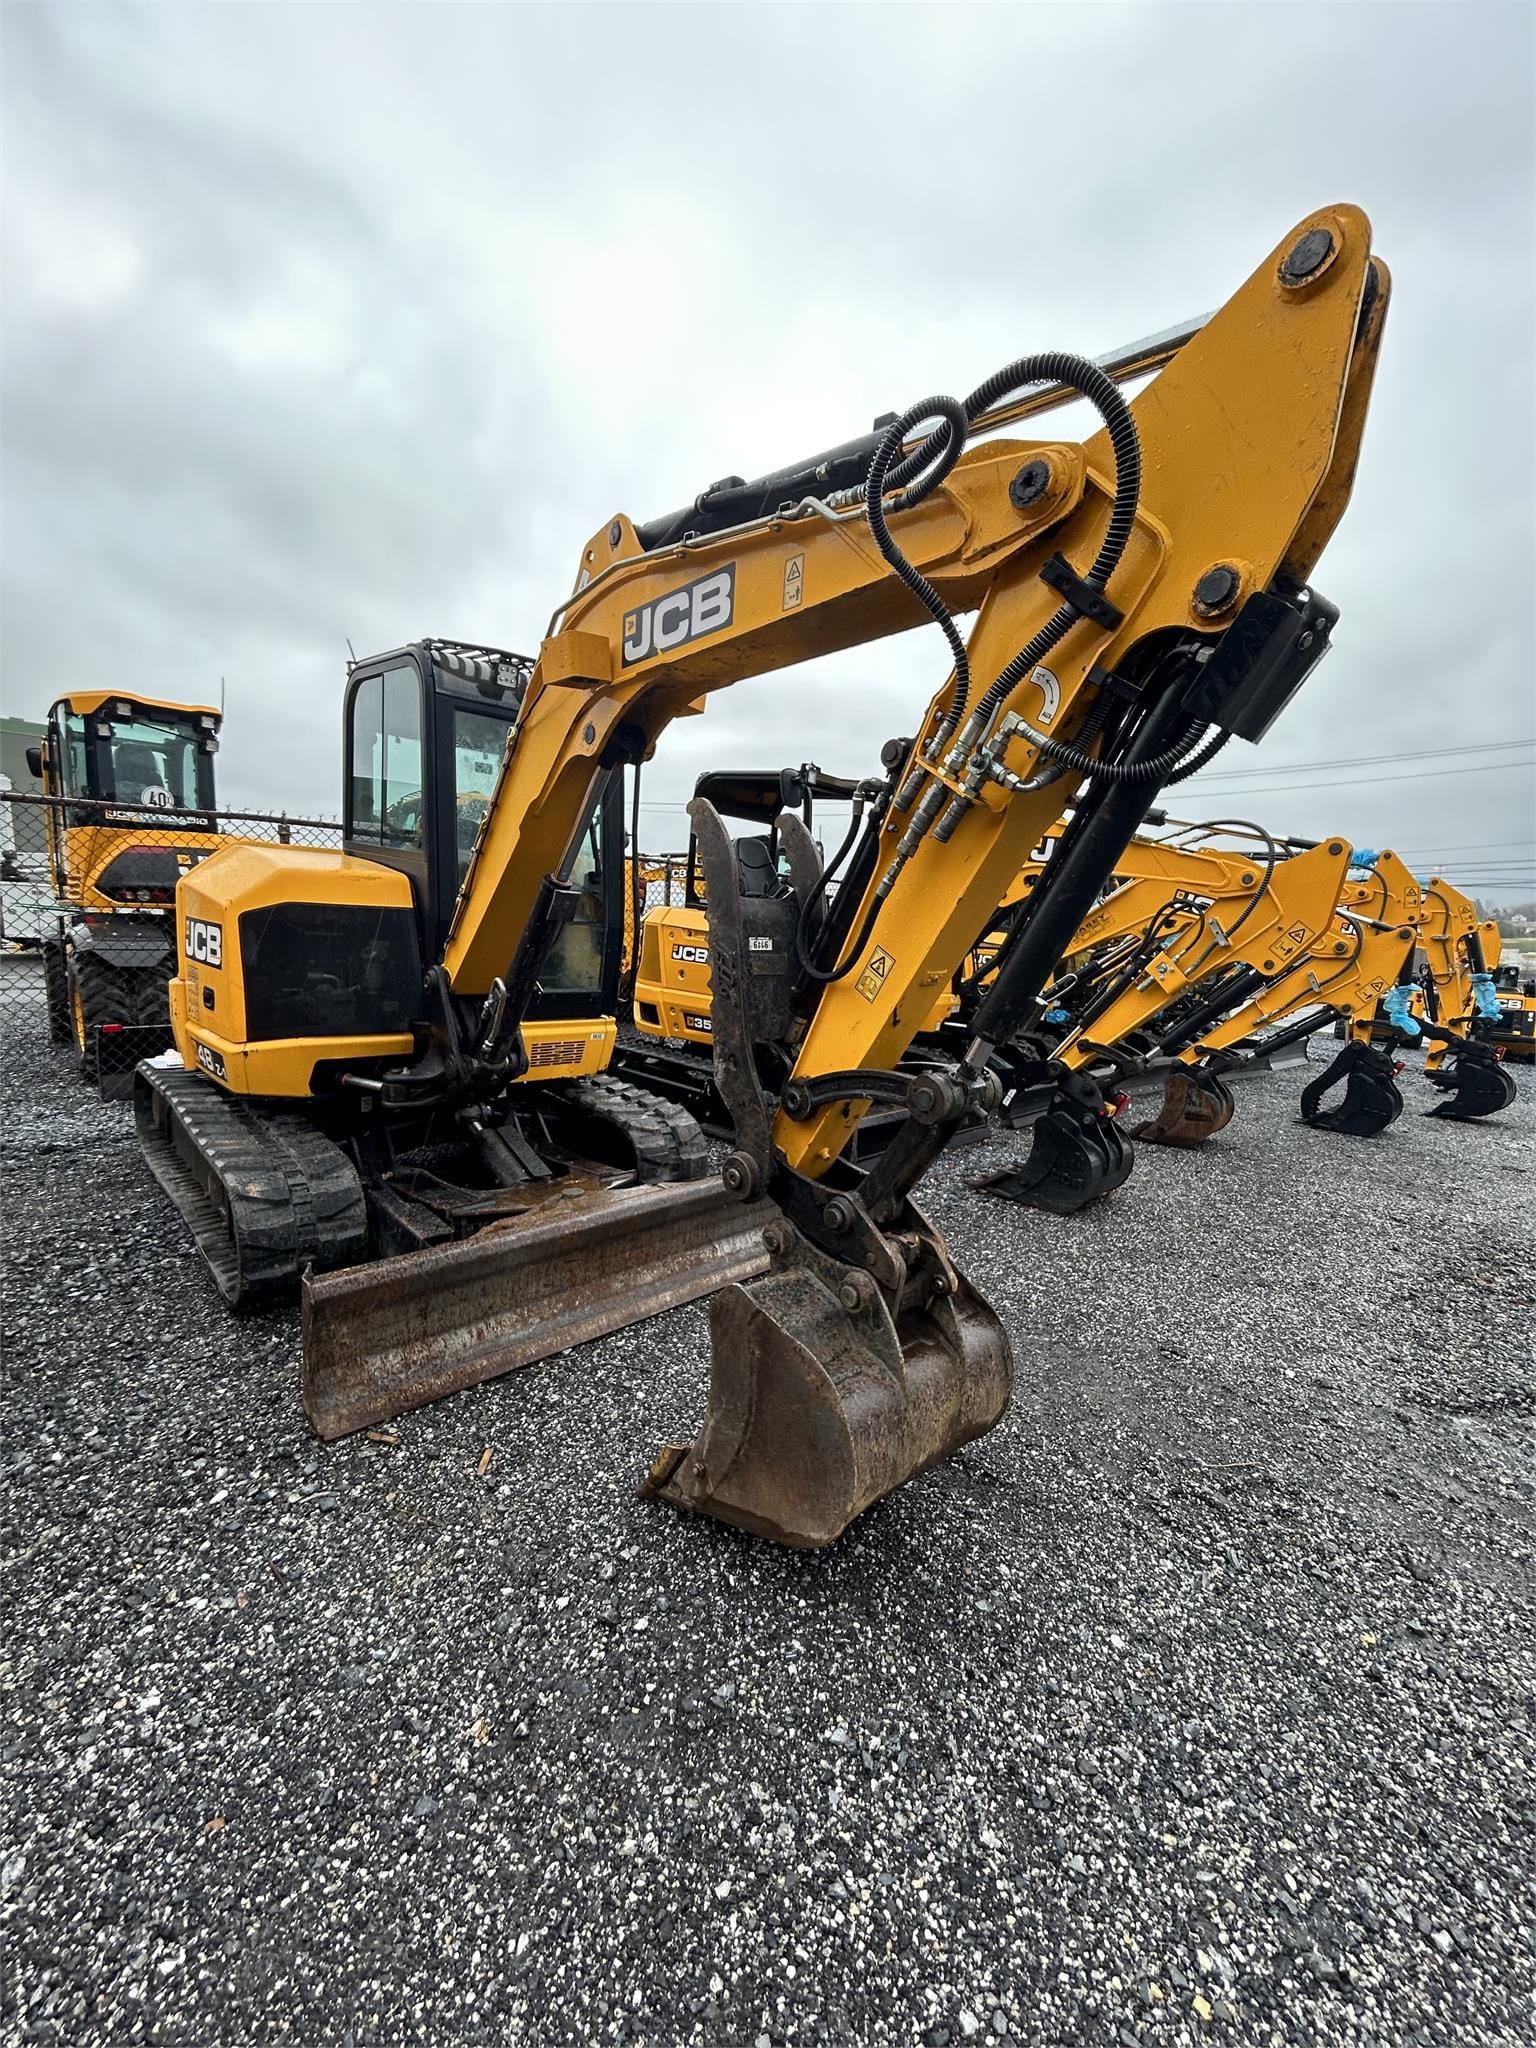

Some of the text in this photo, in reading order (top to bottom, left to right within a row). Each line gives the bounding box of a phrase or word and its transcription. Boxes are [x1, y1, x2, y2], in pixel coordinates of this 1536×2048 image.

[624, 573, 731, 661] JCB
[672, 869, 687, 878] CB
[186, 920, 222, 966] JCB
[672, 946, 708, 963] JCB
[1496, 999, 1522, 1009] CB
